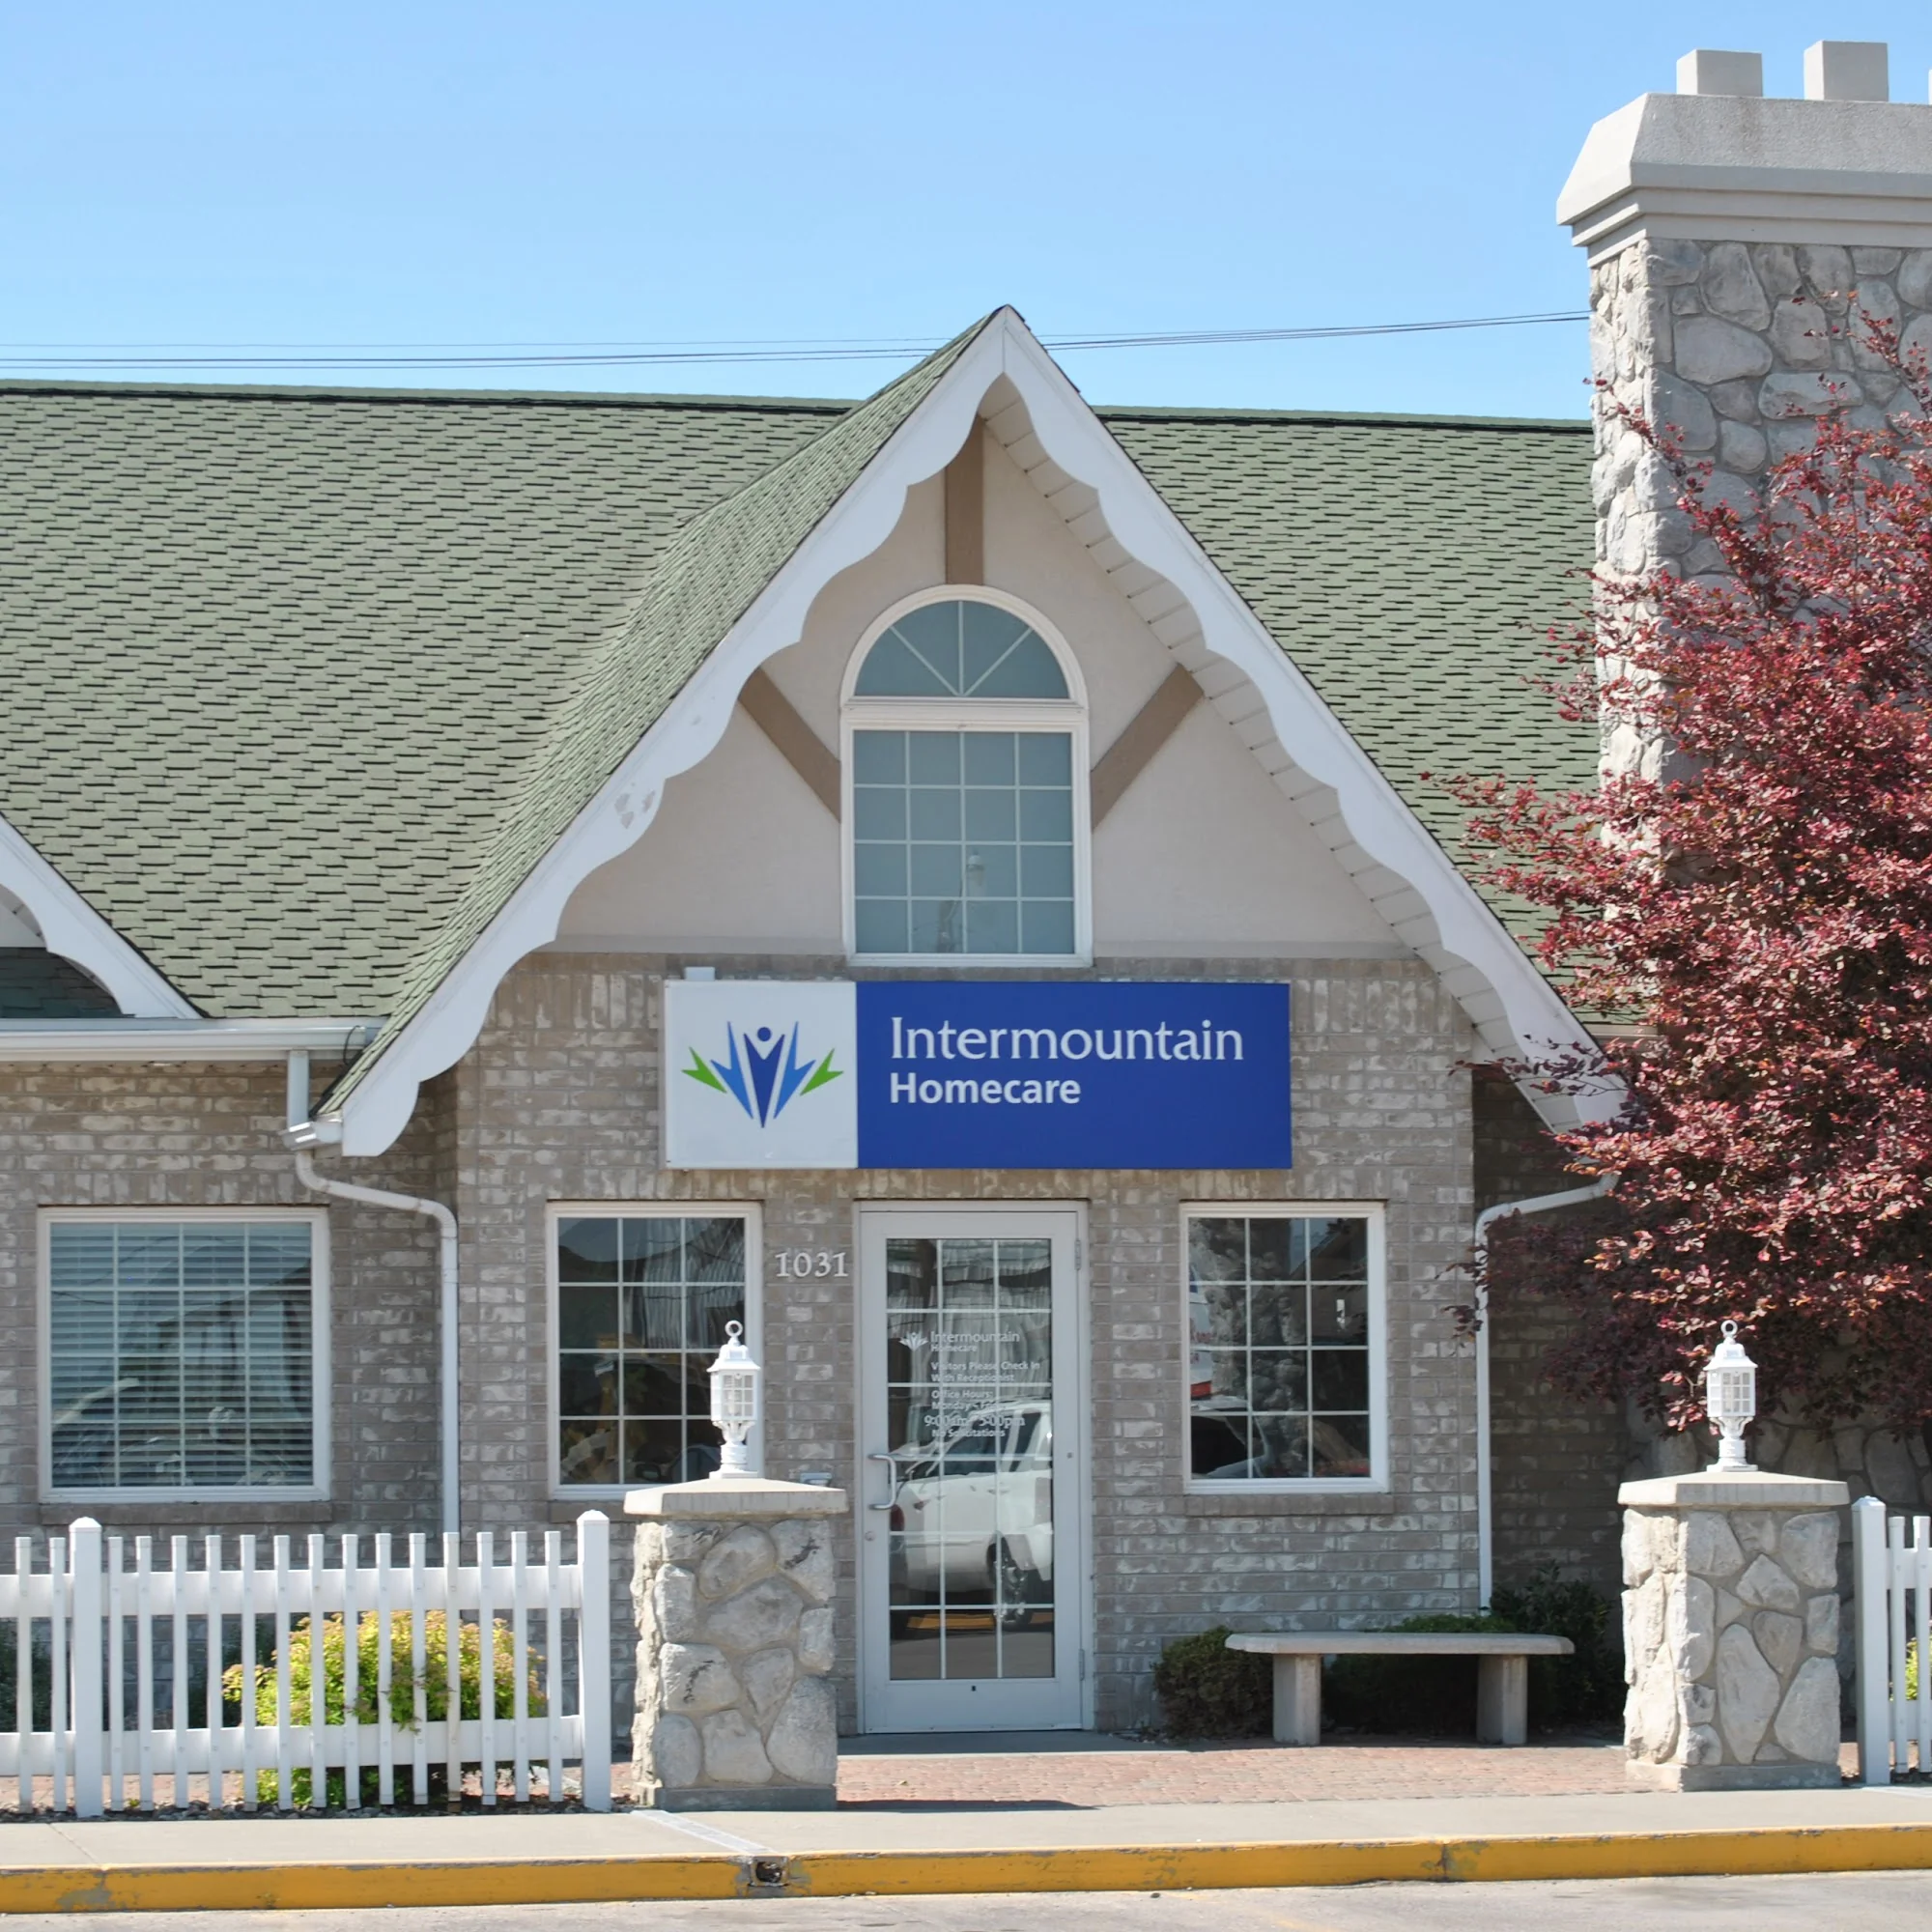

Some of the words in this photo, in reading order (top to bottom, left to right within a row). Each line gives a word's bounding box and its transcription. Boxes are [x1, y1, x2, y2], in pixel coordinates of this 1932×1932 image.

[890, 1016, 1244, 1061] Intermountain
[890, 1072, 1082, 1104] Homecare
[775, 1251, 849, 1277] 1031
[930, 1330, 1021, 1343] Intermountain
[930, 1361, 967, 1371] Vsitors
[1001, 1360, 1029, 1370] Check
[930, 1374, 955, 1382] Wth
[931, 1389, 960, 1399] Ofice
[948, 1429, 1006, 1437] Socitatios
